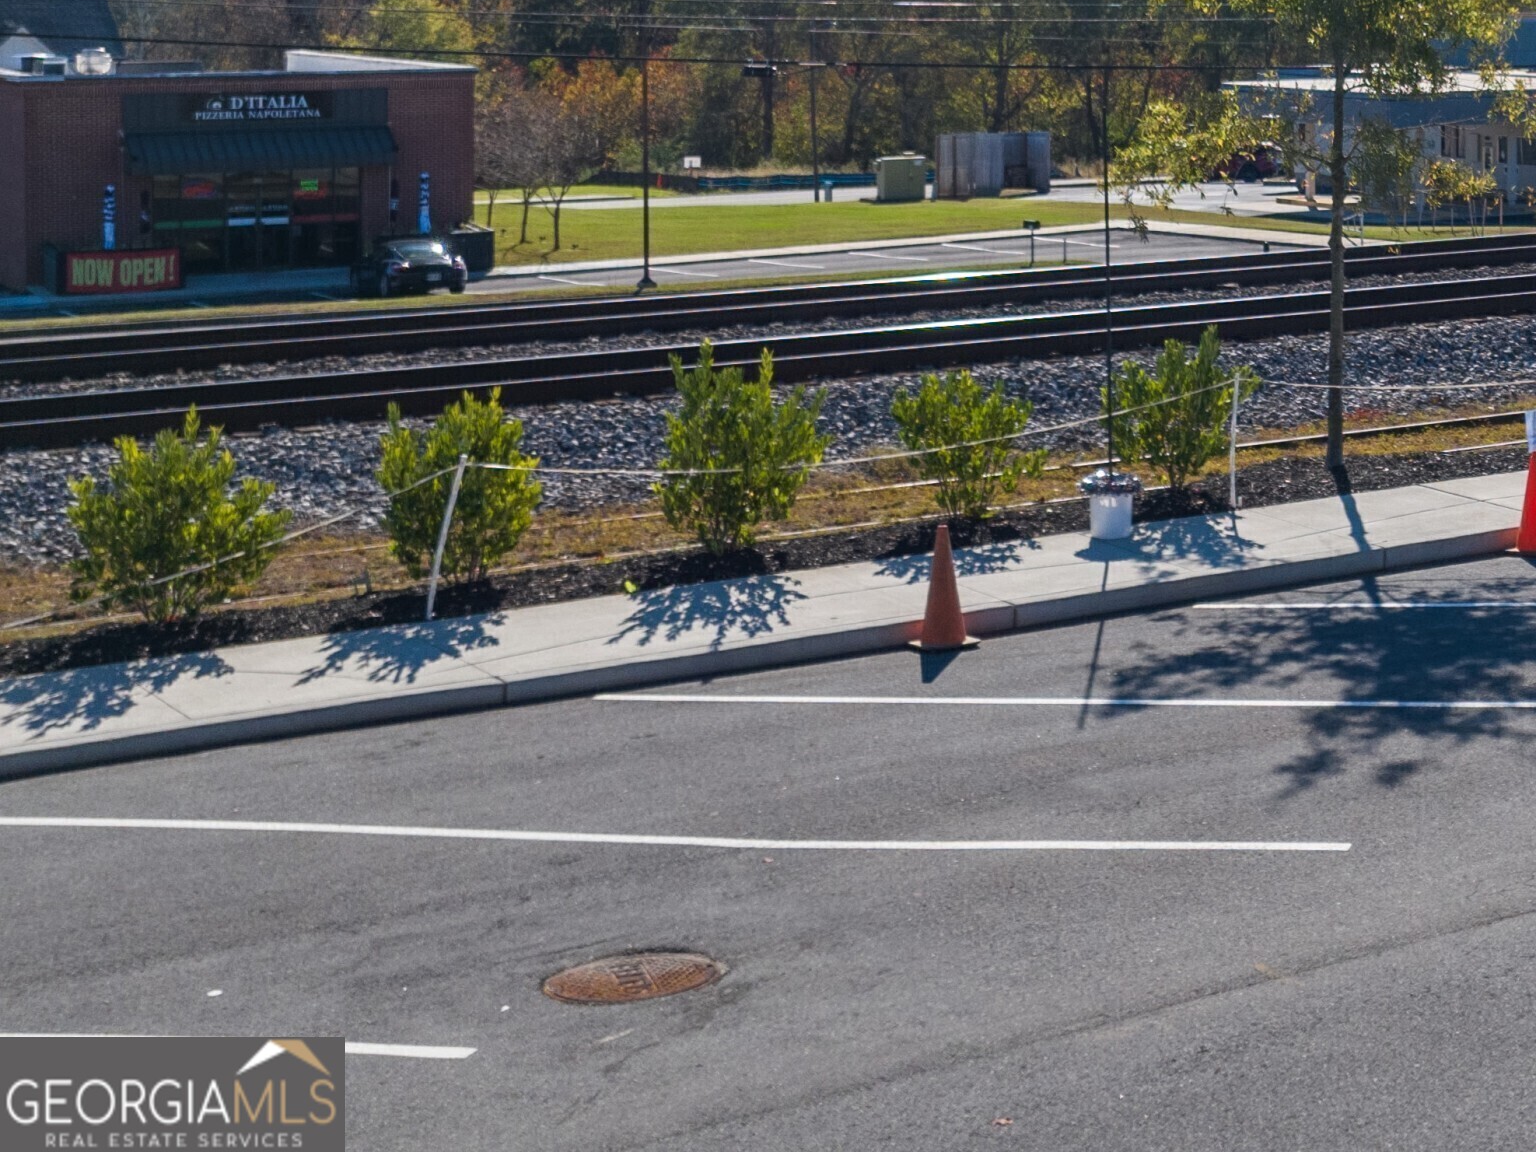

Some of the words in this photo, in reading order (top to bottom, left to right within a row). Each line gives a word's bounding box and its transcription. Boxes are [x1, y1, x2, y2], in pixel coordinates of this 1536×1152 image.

[195, 111, 244, 120] PIZZERIA
[248, 109, 320, 119] NAPOLETANA
[71, 259, 114, 286] NOW
